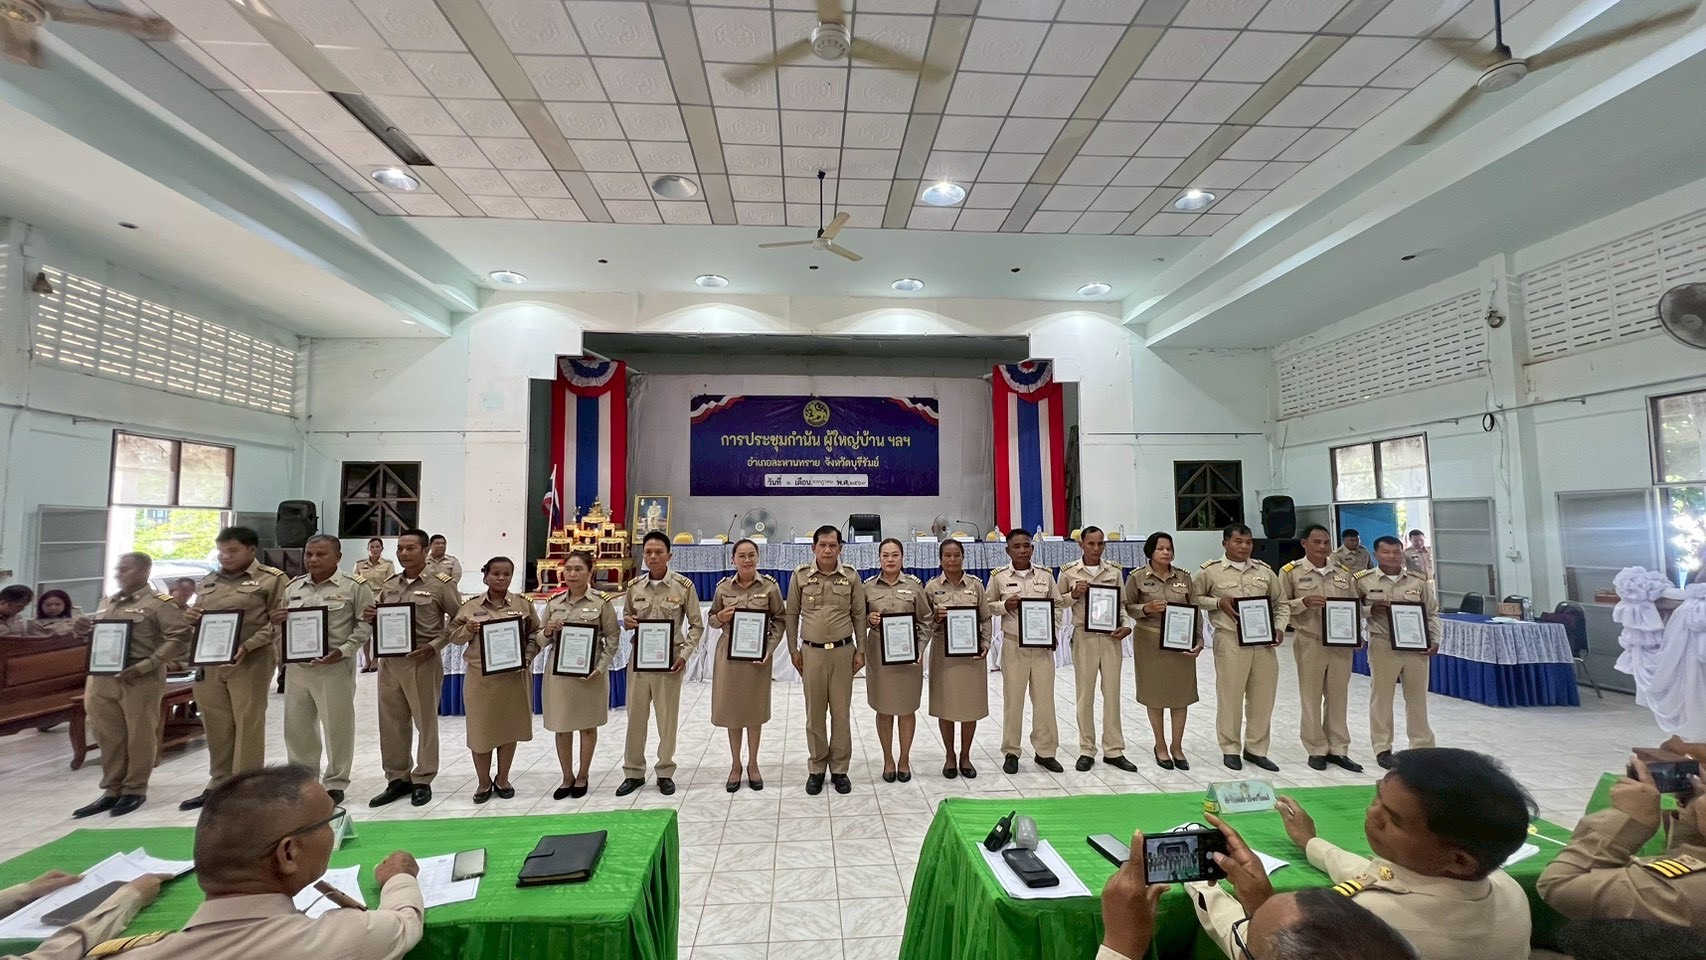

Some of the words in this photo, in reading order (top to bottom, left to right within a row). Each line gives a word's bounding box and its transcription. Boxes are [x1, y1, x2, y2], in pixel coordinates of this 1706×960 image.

[721, 431, 820, 452] การประชุมกำนัน
[824, 430, 884, 452] ผู้ใหญ่บ้าน
[888, 436, 911, 447] ฯลฯ
[747, 456, 820, 467] อำเภอละหานทราย
[824, 456, 880, 471] จังหวัดบุรีรัมย์
[767, 475, 782, 485] วันที่
[794, 477, 811, 485] เดือน
